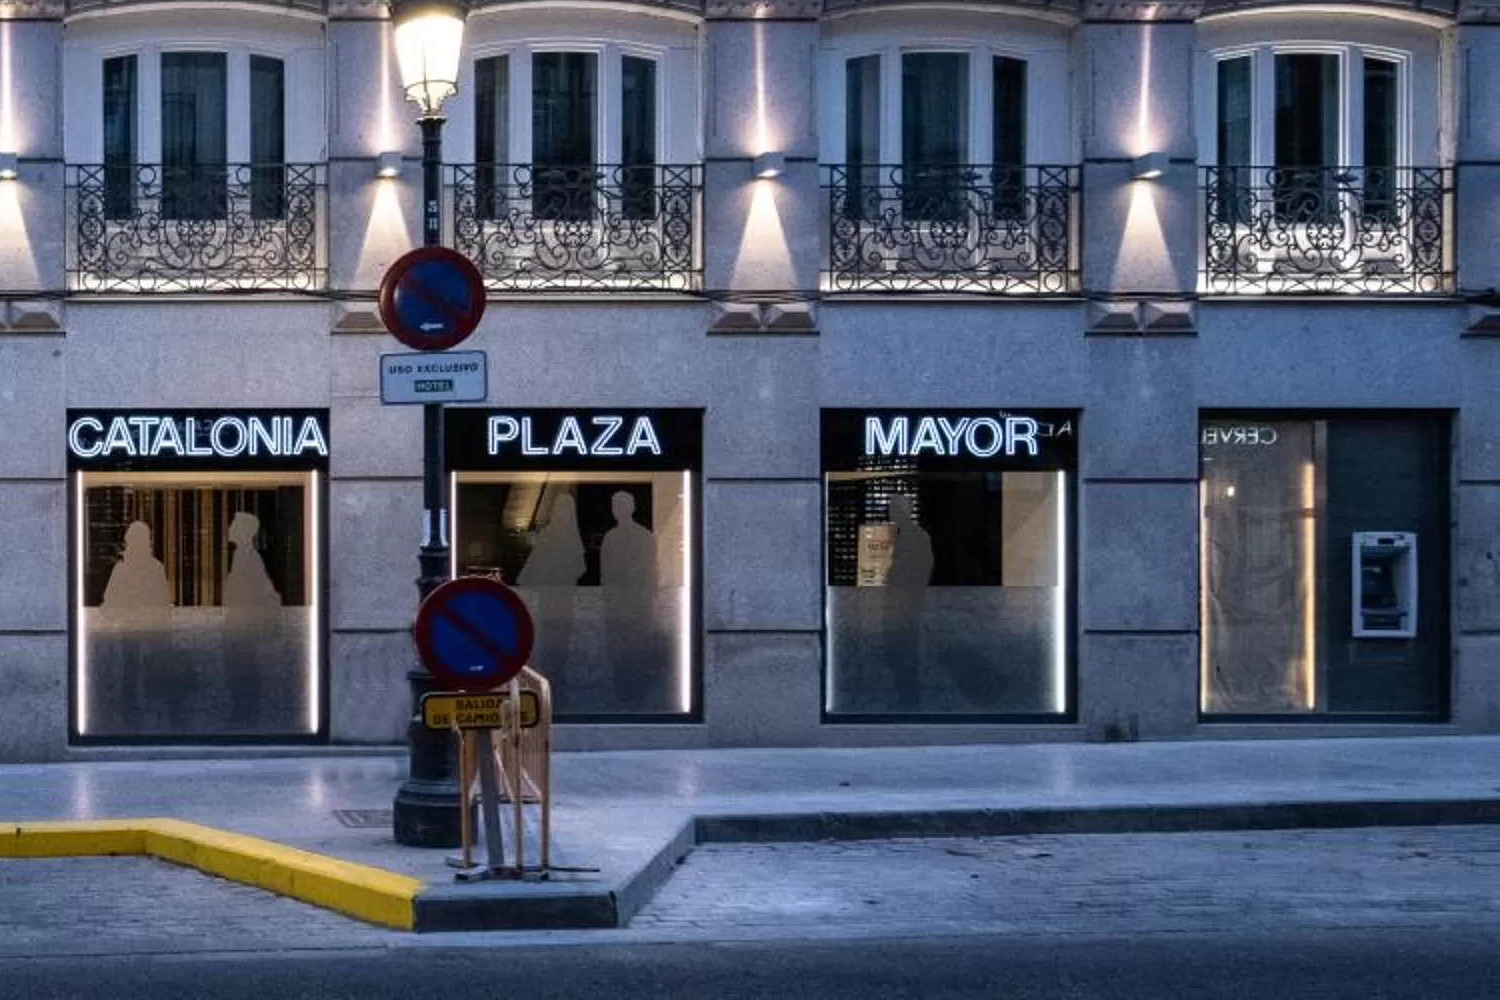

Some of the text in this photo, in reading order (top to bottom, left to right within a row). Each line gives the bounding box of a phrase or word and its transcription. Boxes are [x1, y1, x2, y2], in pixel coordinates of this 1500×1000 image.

[388, 362, 479, 374] USO EXCLUSIVO
[68, 416, 329, 457] CATALONIA
[487, 416, 662, 455] PLAZA
[864, 416, 1039, 457] MAYOR
[433, 714, 449, 725] DE
